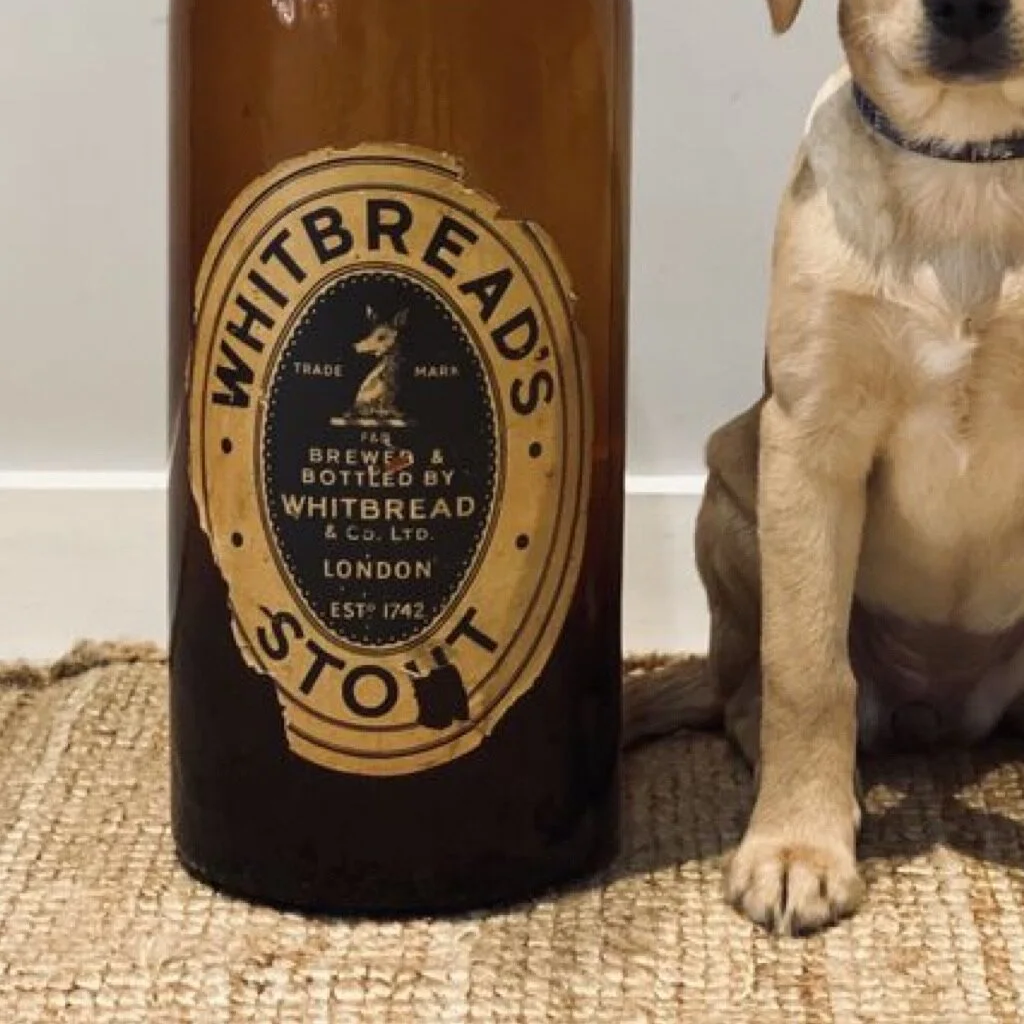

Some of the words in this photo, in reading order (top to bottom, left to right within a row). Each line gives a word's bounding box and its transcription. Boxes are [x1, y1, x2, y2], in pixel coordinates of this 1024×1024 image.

[211, 198, 555, 417] WHITBREAD'S
[293, 362, 343, 377] TRADE
[431, 449, 444, 464] &
[302, 466, 413, 488] BOTTLED
[424, 470, 455, 486] BY
[281, 494, 475, 520] WHITBREAD
[324, 525, 338, 540] &
[324, 559, 432, 579] LONDON
[384, 602, 425, 620] 1742
[257, 607, 499, 718] STOT
